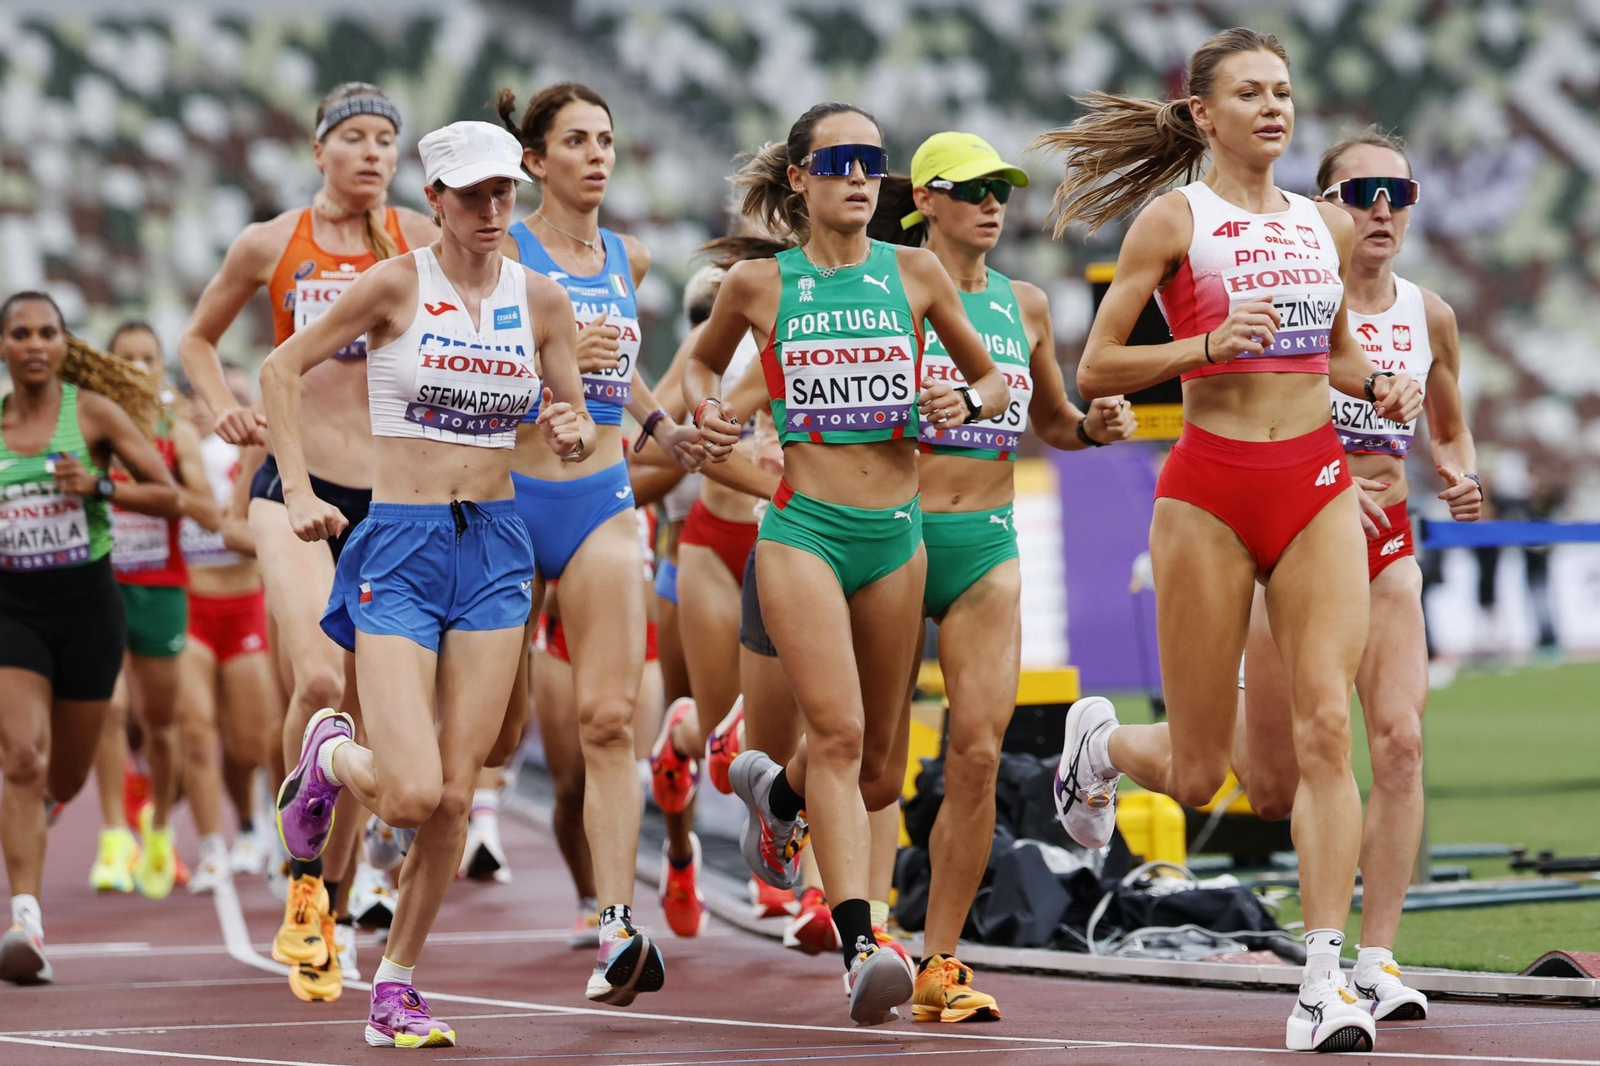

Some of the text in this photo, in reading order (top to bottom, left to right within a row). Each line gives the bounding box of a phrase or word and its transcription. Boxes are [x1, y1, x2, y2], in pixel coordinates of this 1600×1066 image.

[1212, 220, 1251, 238] 4F
[1264, 236, 1296, 246] ORLEN
[1227, 268, 1341, 292] HONDA
[571, 301, 622, 317] TALIA
[798, 295, 814, 303] FPA
[1273, 294, 1336, 328] EZIŃSKA
[787, 308, 904, 340] PORTUGAL
[785, 345, 911, 367] HONDA
[923, 330, 1026, 362] PUGAL
[1360, 344, 1382, 352] RLEN
[420, 353, 537, 379] HONDA
[925, 364, 1031, 391] HODA
[416, 383, 533, 414] STEWARTOVÁ
[792, 373, 908, 405] SANTOS
[1315, 459, 1340, 487] 4F
[0, 501, 80, 521] ONDA
